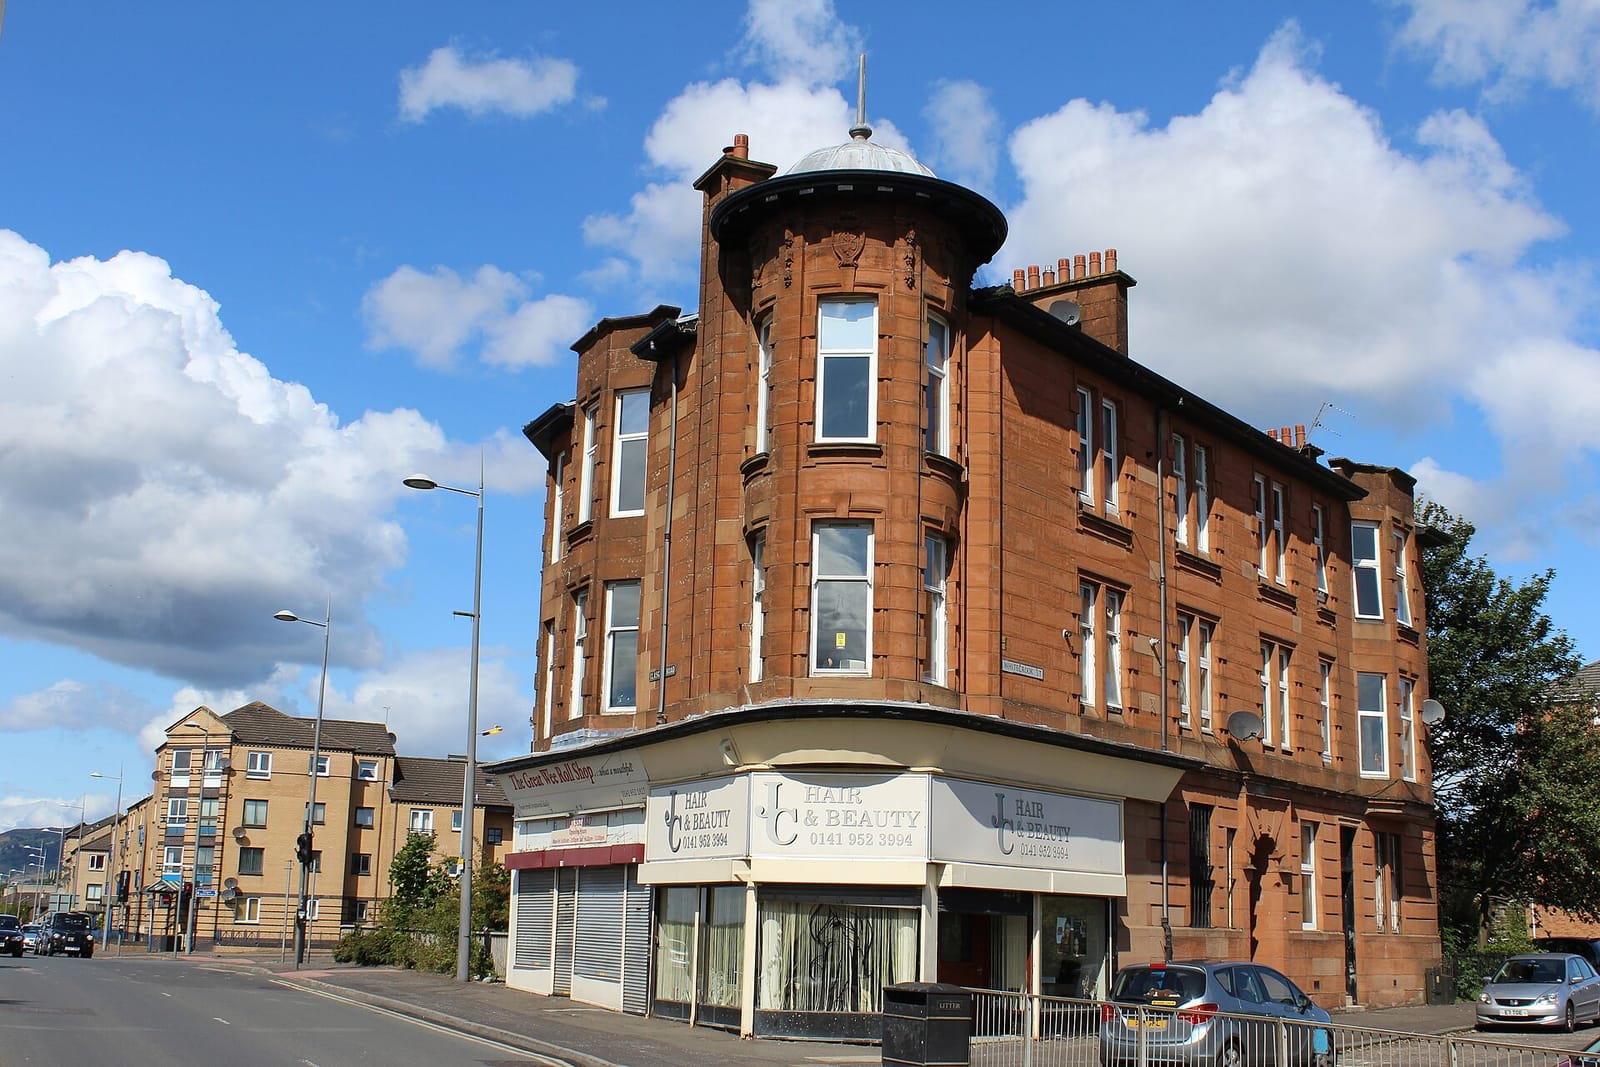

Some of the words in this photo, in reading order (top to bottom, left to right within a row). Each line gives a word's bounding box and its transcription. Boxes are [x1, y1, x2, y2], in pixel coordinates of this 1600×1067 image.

[508, 772, 526, 790] The
[522, 772, 544, 789] Great
[539, 768, 559, 784] Wee
[555, 763, 575, 783] Roll
[572, 761, 595, 784] Shop
[684, 791, 708, 810] HAIR
[804, 786, 862, 804] HAIR
[1016, 799, 1044, 818] HAIR
[684, 814, 691, 831] &
[692, 809, 731, 830] BEAUTY
[804, 810, 818, 827] &
[825, 809, 921, 828] BEAUTY
[682, 835, 697, 849] 0141
[698, 833, 711, 848] 952
[712, 832, 728, 847] 3994
[810, 832, 842, 846] 0141
[848, 832, 874, 846] 952
[879, 832, 913, 847] 3994
[1017, 822, 1025, 838] &
[1027, 822, 1071, 843] BEAUTY
[1020, 843, 1037, 857] 0141
[1038, 845, 1052, 858] 952
[1053, 846, 1069, 860] 3994
